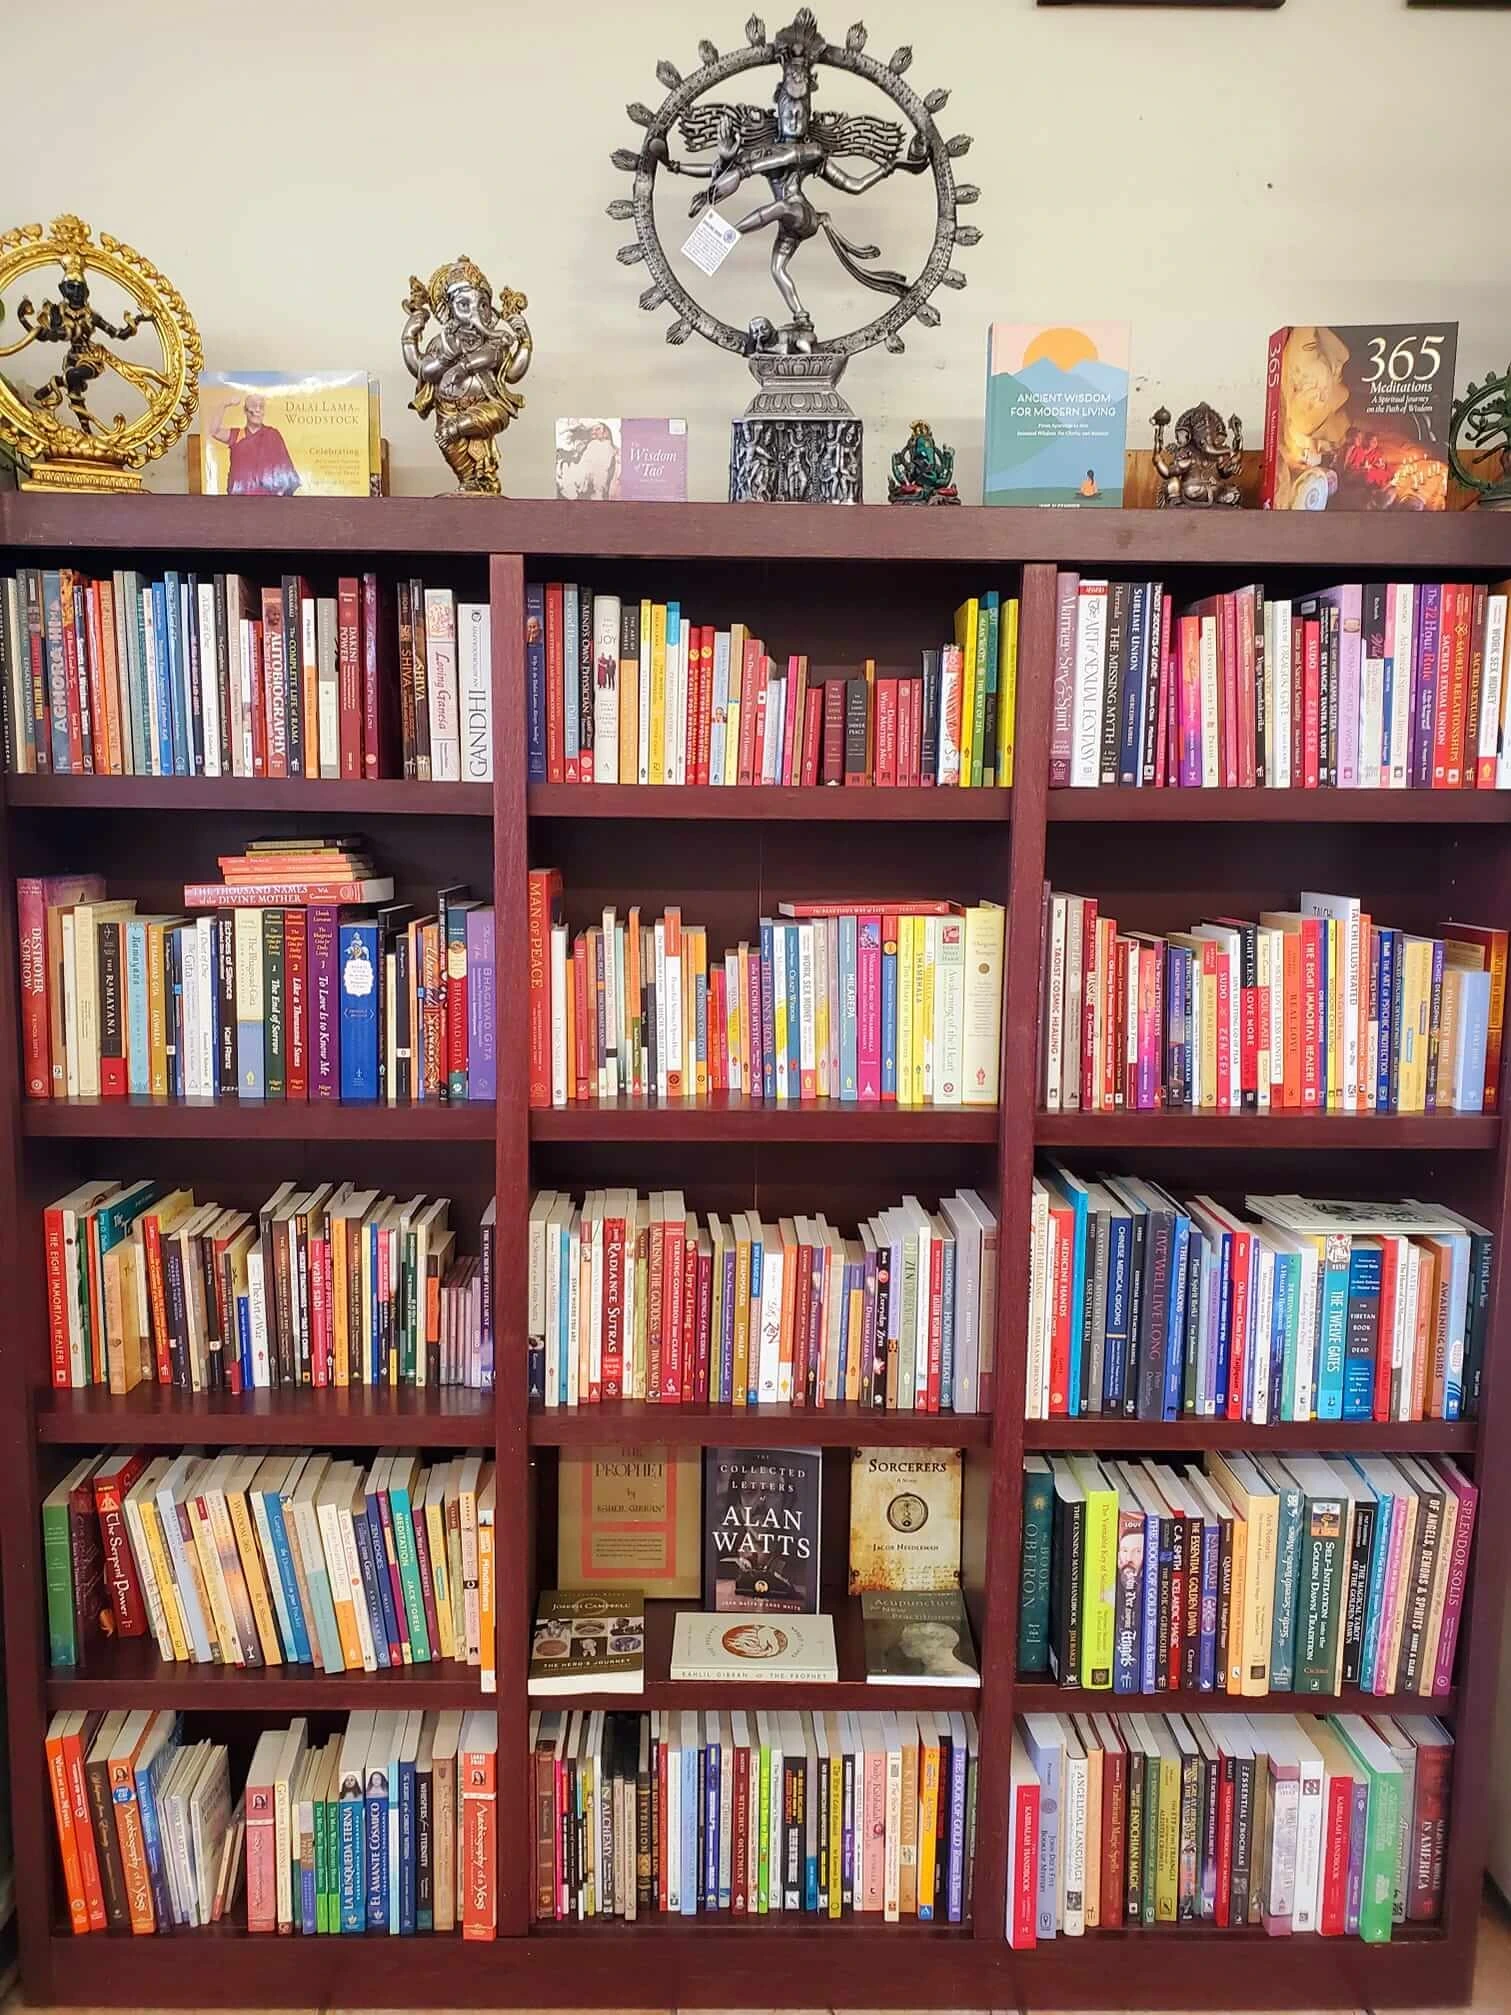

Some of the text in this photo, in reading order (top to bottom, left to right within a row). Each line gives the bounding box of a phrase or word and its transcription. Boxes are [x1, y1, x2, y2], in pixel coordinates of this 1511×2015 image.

[1269, 343, 1281, 387] 365
[1361, 335, 1445, 382] 365
[1010, 407, 1116, 417] FOR MODERN LIVING
[1017, 392, 1111, 403] ANCIENT WISDOM
[1370, 381, 1432, 393] Meditations
[1378, 396, 1404, 405] Spiritual
[1406, 395, 1429, 406] Journey
[285, 414, 360, 425] WOODSTOCK
[630, 448, 677, 463] Wisdom
[641, 464, 664, 477] Tao
[1129, 588, 1142, 671] SUBLIME UNION
[289, 639, 298, 687] COMPLETE
[415, 663, 425, 701] SHIVA
[1104, 626, 1120, 744] THE MISSING MYTH
[1437, 634, 1451, 745] SACRED SEXUAL UNION
[271, 632, 286, 756] AUTOBIOGRAPHY
[290, 689, 299, 707] LIFE
[291, 718, 299, 745] RAMA
[468, 689, 488, 777] GANDHI
[32, 928, 43, 996] DESTROYER
[530, 883, 544, 988] MAN OF PEACE
[1246, 930, 1255, 961] FIGHT
[21, 938, 32, 989] SORROW
[1247, 963, 1255, 988] LESS
[751, 975, 760, 1046] KITCHEN MYSTIC
[847, 973, 855, 1018] MILAREPA
[1051, 947, 1061, 1054] TAOIST COSMIC HEALING
[1305, 942, 1314, 1082] THE EIGHT IMMORTAL HEALERS
[319, 976, 329, 1076] To Love Is to Know Me
[50, 1232, 64, 1364] THE EIGHT IMMORTAL HEALERS
[311, 1260, 322, 1311] wabi sabi
[607, 1242, 621, 1353] RADIANCE SUTRAS
[650, 1227, 661, 1330] AROUSING THE GODDESS
[1059, 1237, 1070, 1318] MEDICINE HANDS
[1113, 1226, 1126, 1326] CHINESE MEDICAL QIGONG
[1150, 1229, 1169, 1361] LIVE WELL LIVE LONG
[1327, 1291, 1344, 1372] THE TWELVE GATES
[1435, 1281, 1449, 1379] AWAKENING OSIRIS
[595, 1463, 664, 1477] PROPHET
[720, 1464, 806, 1478] COLLECTED
[731, 1481, 795, 1492] LETTERS
[868, 1458, 946, 1472] SORCERERS
[722, 1506, 803, 1531] ALAN
[1422, 1512, 1438, 1547] ANGELS,
[1429, 1499, 1440, 1511] OF
[105, 1512, 129, 1616] The Serpent Power
[371, 1522, 383, 1569] ZEN ECHOES
[395, 1511, 408, 1567] MEDITATION
[712, 1531, 811, 1559] WATTS
[1022, 1523, 1038, 1609] OBERON
[1172, 1525, 1183, 1571] C.A. SMITH
[1449, 1499, 1473, 1606] SPLENDOR SOLIS
[481, 1559, 490, 1612] Mindfulness
[1147, 1518, 1158, 1617] THE BOOK OF GOLD
[1187, 1522, 1200, 1637] THE ESSENTIAL GOLDEN DAWN
[1418, 1550, 1433, 1584] DEMONS
[406, 1579, 420, 1633] JACK FOREM
[1306, 1542, 1319, 1661] GOLDEN DAWN TRADITION
[1412, 1597, 1427, 1631] SPIRITS
[640, 1802, 648, 1852] KYBALION
[953, 1753, 963, 1846] THE BOOK OF GOLD
[1074, 1771, 1085, 1882] ANGELICAL LANGUAGE
[473, 1802, 487, 1869] Autobiography
[602, 1802, 611, 1859] ALCHEMY
[736, 1794, 745, 1885] WITCHES' OINTMENT
[1023, 1806, 1033, 1893] KABBALAH HANDBOOK
[1109, 1784, 1121, 1873] Traditional Magic Spells
[1129, 1809, 1139, 1892] ENOCHIAN MAGIC
[1418, 1821, 1432, 1890] IN AMERICA
[473, 1885, 488, 1910] Yogi
[477, 1871, 485, 1879] of
